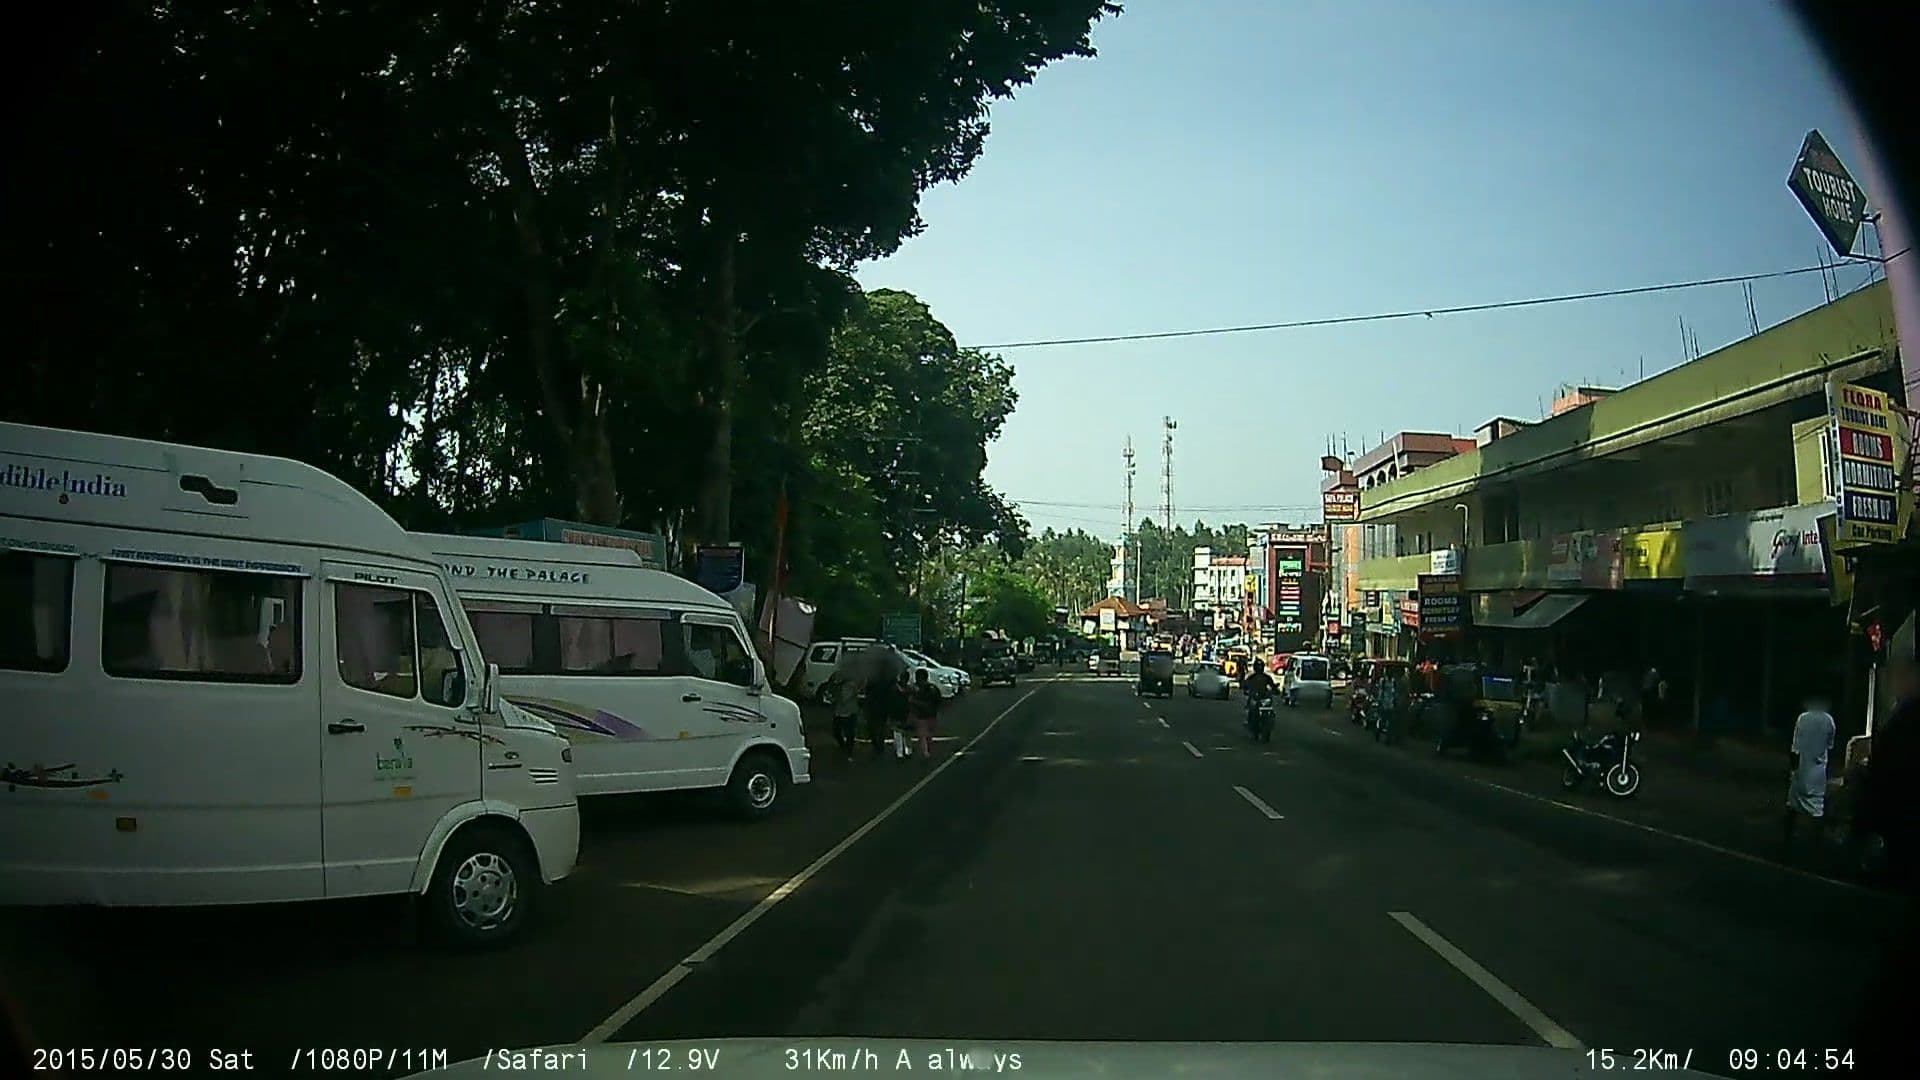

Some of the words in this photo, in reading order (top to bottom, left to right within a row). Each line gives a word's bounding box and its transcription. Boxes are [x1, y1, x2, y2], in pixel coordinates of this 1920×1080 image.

[1802, 167, 1856, 202] TOURIST
[1822, 196, 1854, 223] HOME
[1842, 388, 1883, 411] FLORA
[1852, 431, 1884, 458] ROOMS
[1844, 461, 1893, 489] DORMITORY
[1852, 495, 1879, 519] FRESH
[1880, 499, 1891, 520] UP
[353, 572, 398, 584] PILOT
[487, 566, 519, 580] THE
[526, 568, 591, 584] PALACE
